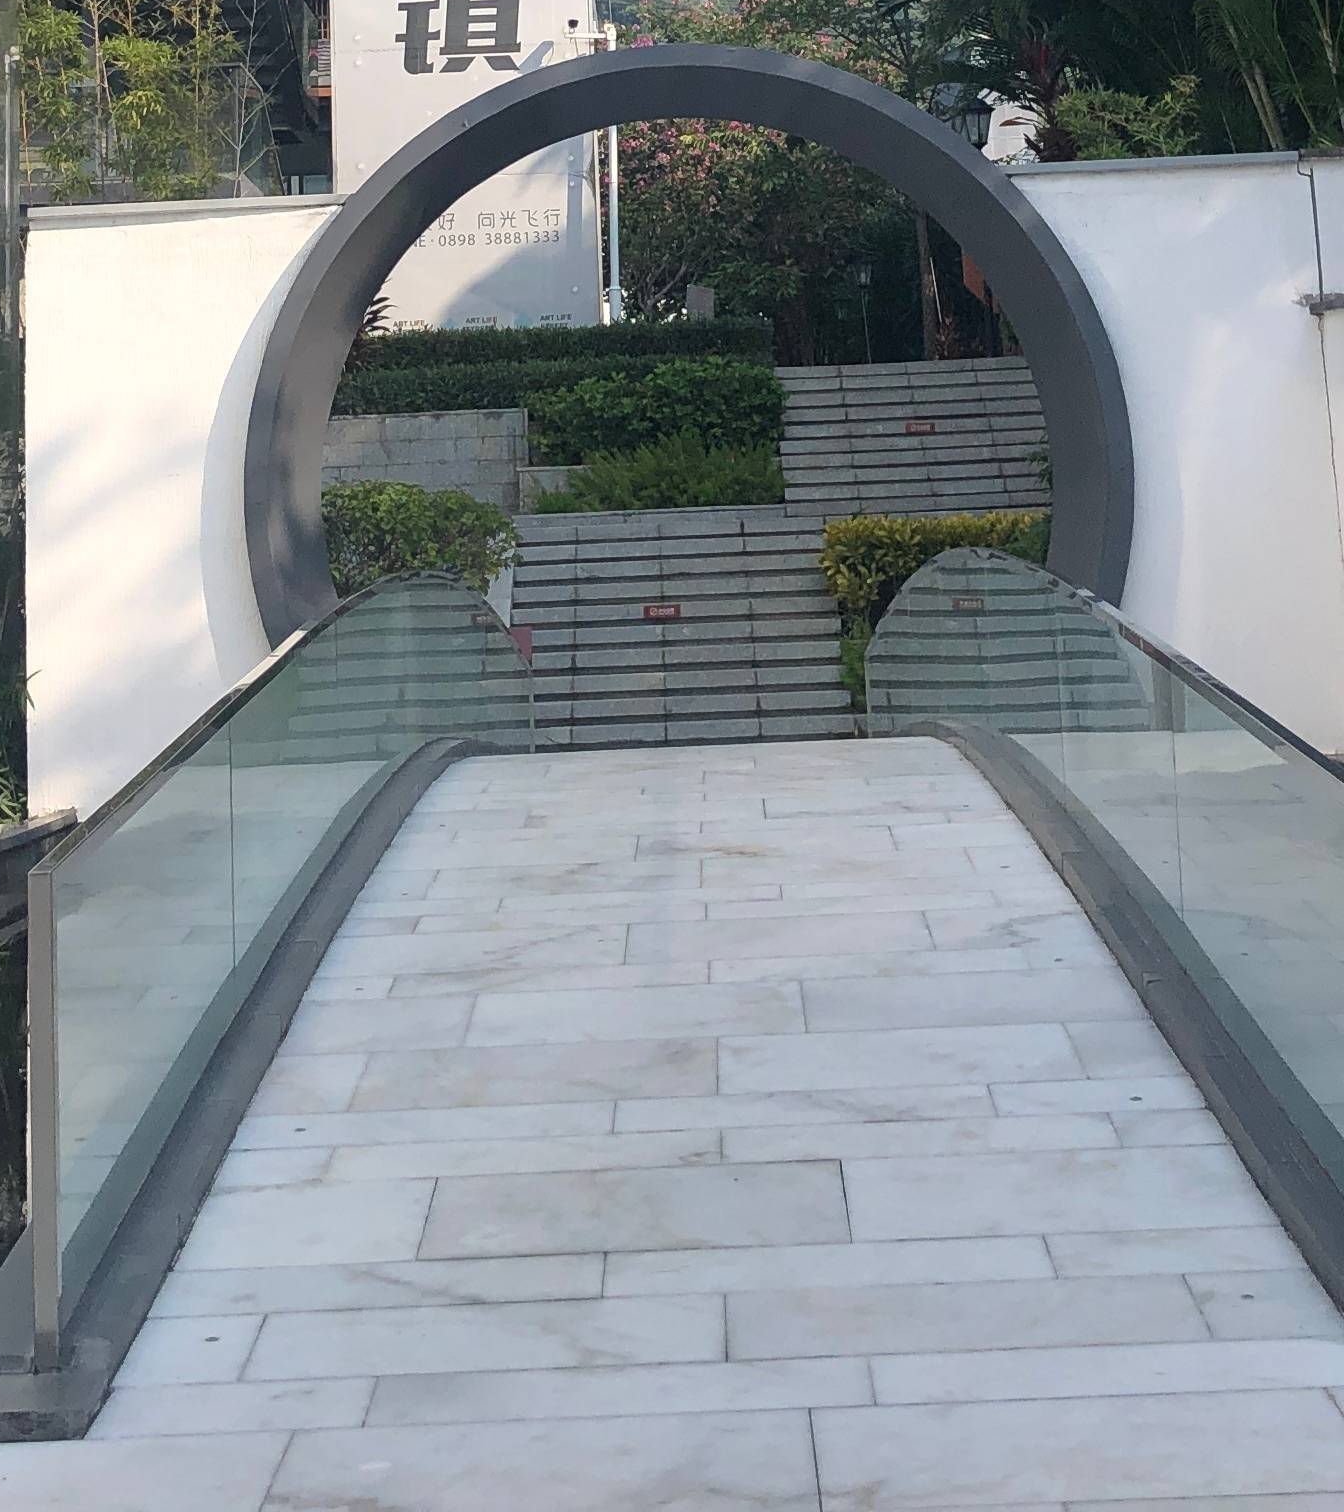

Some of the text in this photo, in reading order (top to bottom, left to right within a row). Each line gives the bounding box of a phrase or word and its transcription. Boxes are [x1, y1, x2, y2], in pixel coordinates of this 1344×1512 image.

[478, 208, 560, 229] 向光飞行
[484, 230, 560, 246] 38881333
